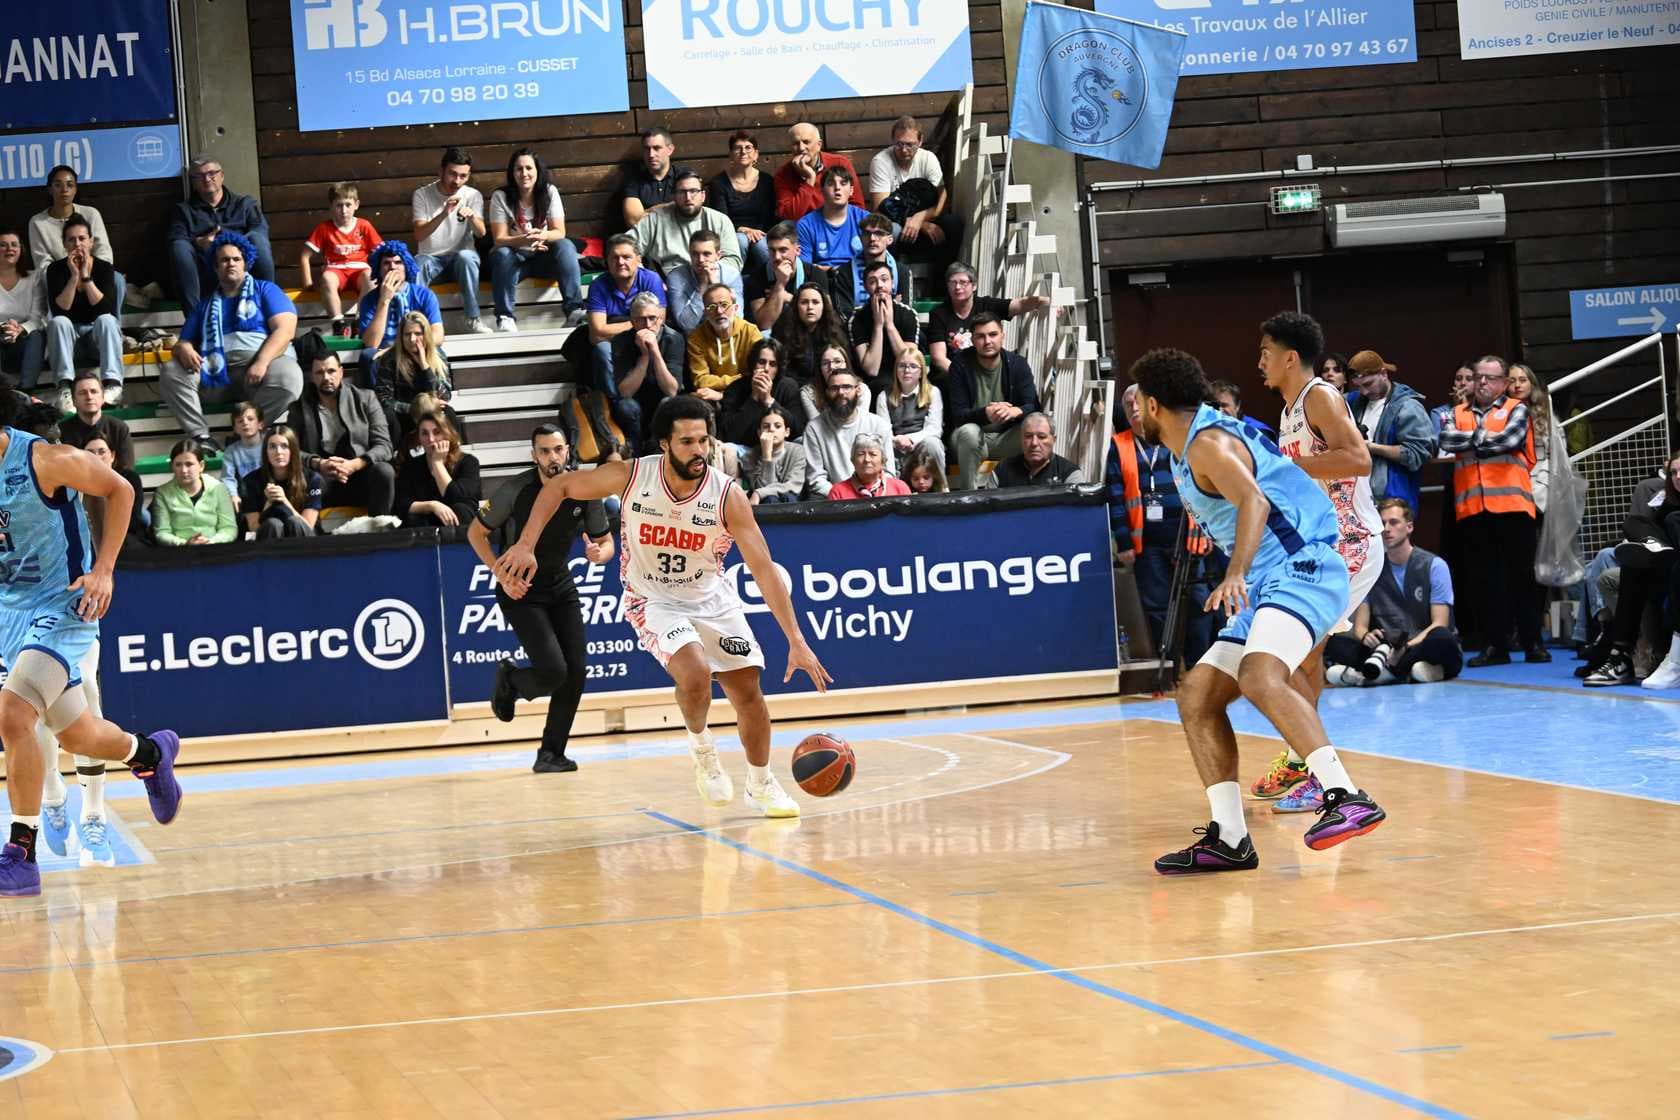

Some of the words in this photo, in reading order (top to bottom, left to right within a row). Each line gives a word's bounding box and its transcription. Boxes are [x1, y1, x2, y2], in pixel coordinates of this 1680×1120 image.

[400, 0, 611, 45] H.BRUN
[680, 0, 921, 40] ROUCHY
[1190, 16, 1267, 34] Travaux
[1273, 10, 1298, 29] de
[1304, 7, 1368, 28] l'Allier
[1535, 10, 1569, 22] GENIE
[1571, 7, 1606, 19] CIVILE
[1275, 45, 1297, 60] 04
[1304, 44, 1326, 59] 70
[1331, 42, 1352, 57] 97
[1359, 40, 1381, 55] 43
[1387, 38, 1409, 54] 67
[1468, 34, 1521, 50] Ancises
[1525, 34, 1534, 46] 2
[1546, 30, 1604, 44] Creuzier
[1607, 27, 1619, 39] le
[1623, 24, 1655, 38] Neuf
[0, 32, 139, 83] ANNAT
[346, 69, 366, 84] 15
[370, 67, 389, 82] Bd
[393, 66, 441, 82] Alsace
[445, 62, 505, 78] Lorraine
[518, 57, 579, 73] CUSSET
[1058, 39, 1107, 59] DRAGON
[1111, 47, 1135, 74] CLUB
[387, 90, 413, 107] 04
[419, 88, 445, 105] 70
[451, 86, 476, 103] 98
[482, 84, 508, 100] 20
[514, 82, 539, 98] 39
[0, 142, 46, 181] TIO
[1585, 290, 1636, 308] SALON
[639, 522, 706, 552] SCABB
[657, 552, 687, 574] 33
[802, 552, 1091, 601] boulanger
[807, 604, 913, 641] Vichy
[117, 626, 349, 673] E.Leclerc
[452, 651, 463, 664] 4
[586, 639, 634, 655] 03300
